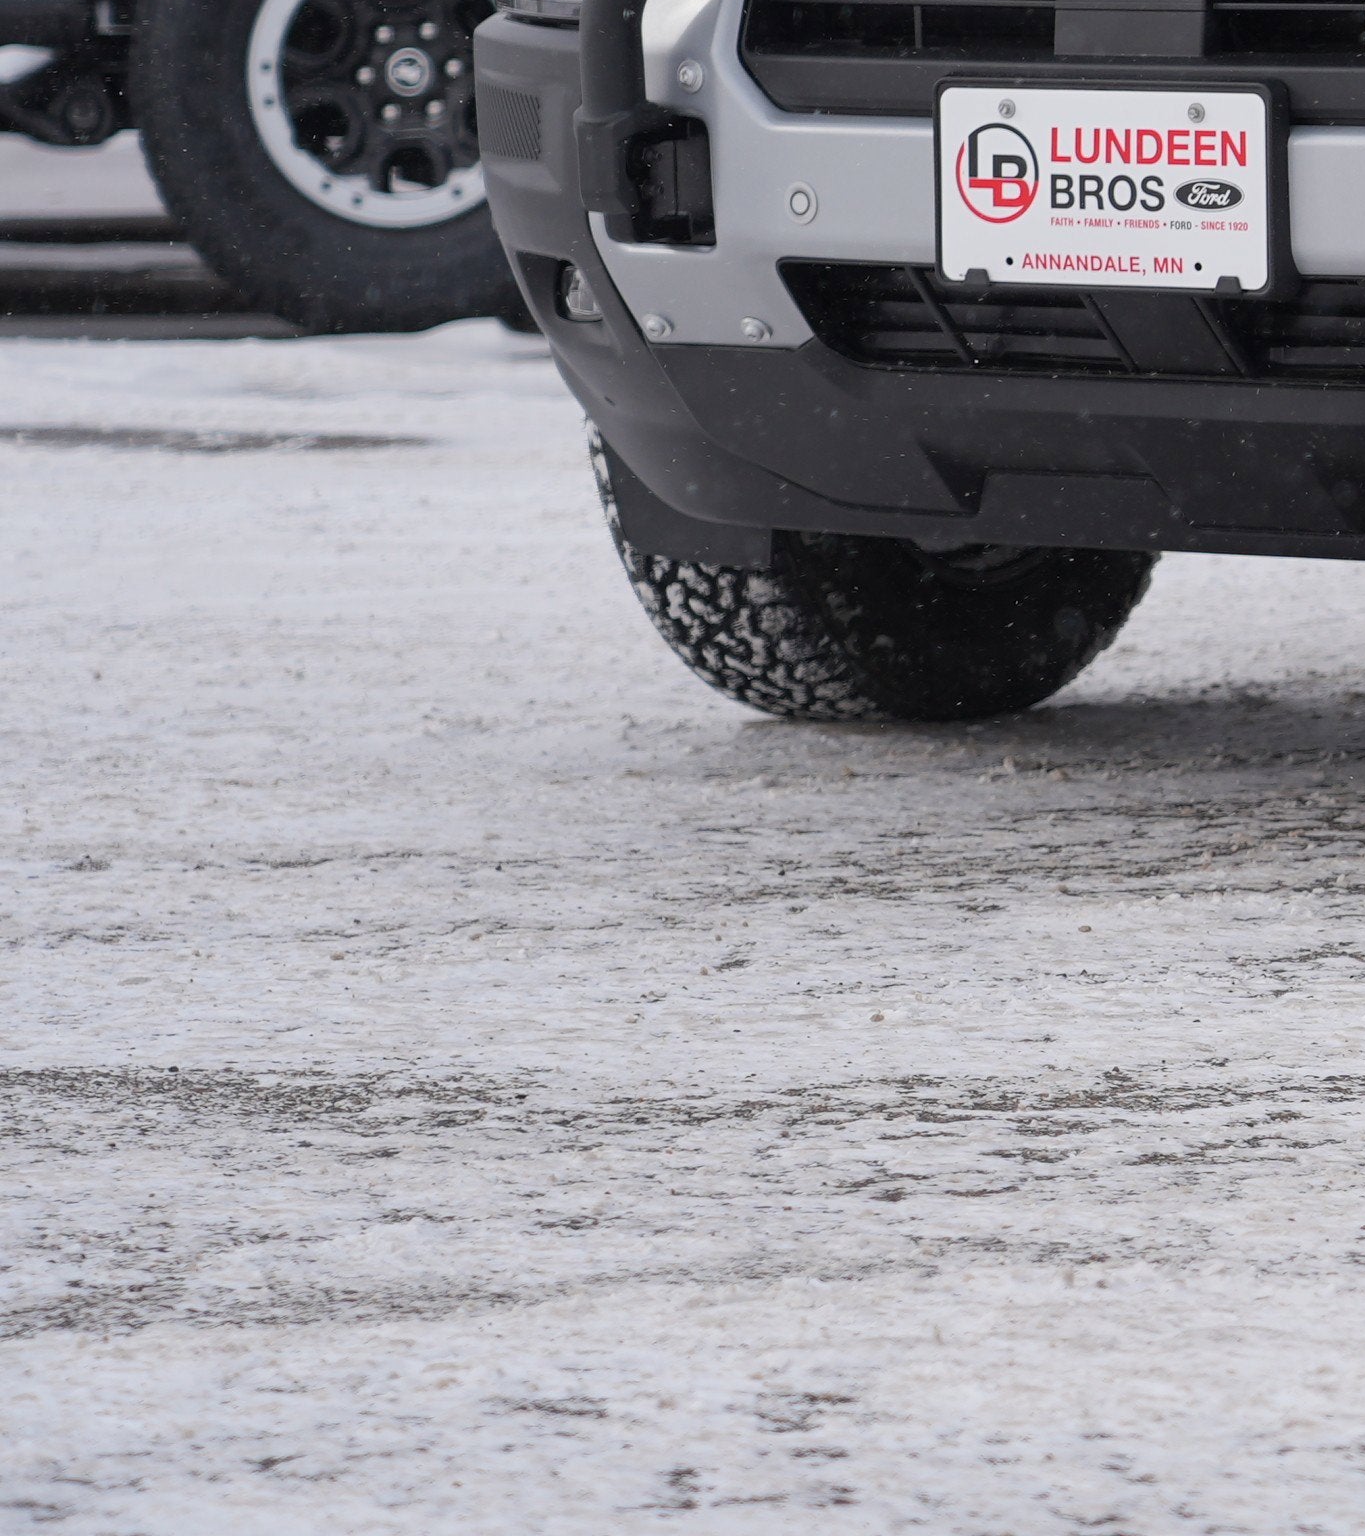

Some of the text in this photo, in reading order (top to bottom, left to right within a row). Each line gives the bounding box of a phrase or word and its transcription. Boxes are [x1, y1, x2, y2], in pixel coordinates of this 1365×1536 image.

[1050, 127, 1247, 166] LUNDEEN
[1050, 174, 1165, 212] BROS
[1186, 180, 1232, 208] Ford
[1050, 216, 1249, 232] FAITH FAMILY FRIENDS FORD SINCE 1920
[1022, 253, 1183, 276] ANNANDALE, MN
